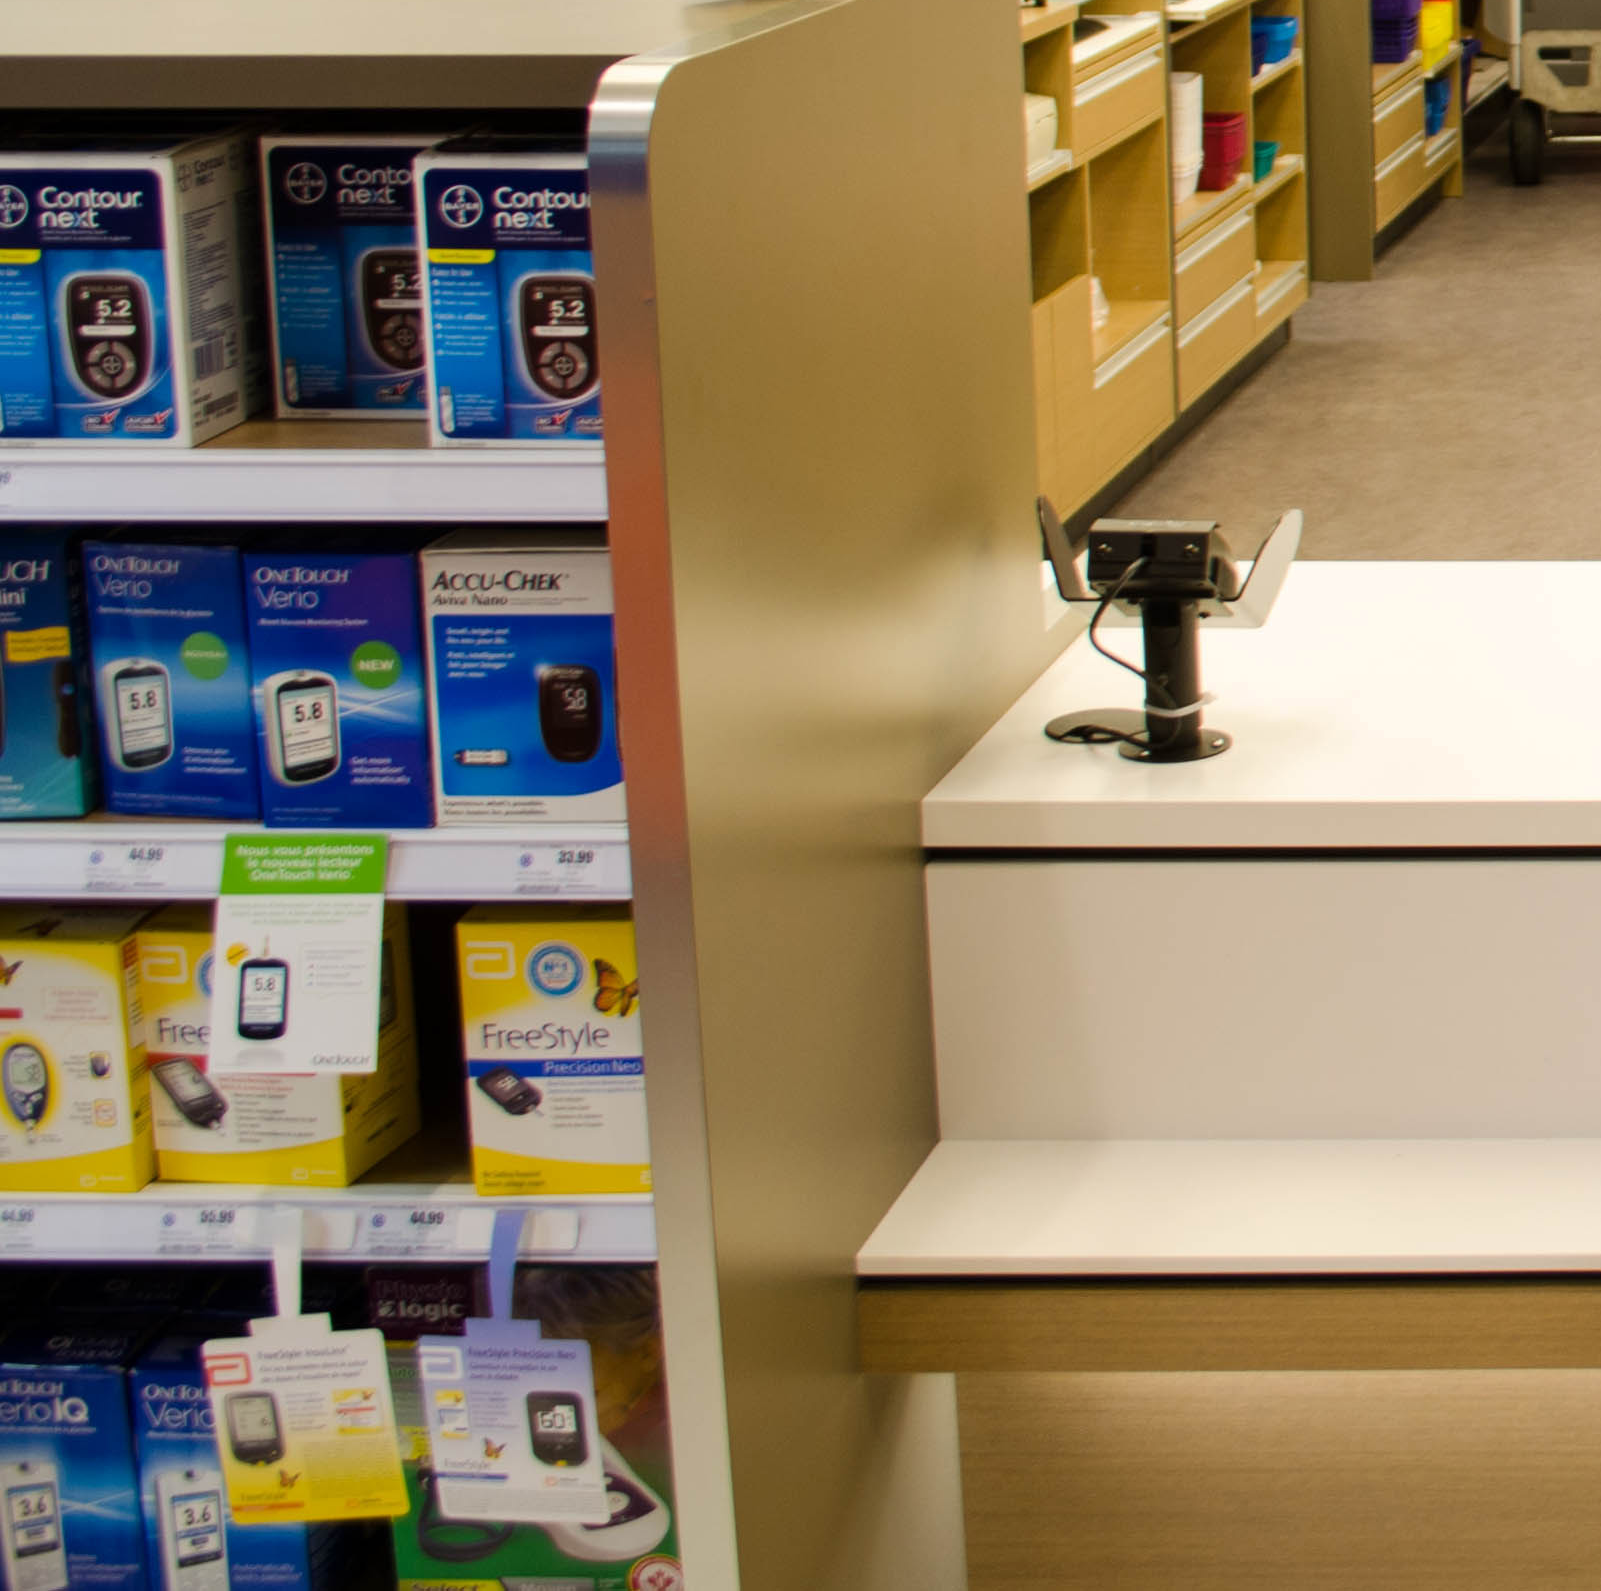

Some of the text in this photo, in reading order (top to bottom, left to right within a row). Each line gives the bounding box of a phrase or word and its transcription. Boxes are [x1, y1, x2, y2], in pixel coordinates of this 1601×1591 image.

[337, 164, 412, 185] Conto
[38, 186, 143, 209] Contour
[338, 186, 396, 206] next
[40, 209, 99, 229] next
[493, 209, 554, 229] next
[97, 299, 132, 318] 5.2
[550, 299, 585, 318] 5.2
[96, 574, 153, 599] Verio
[432, 570, 563, 591] ACCU-CHEK
[256, 585, 320, 610] Verio
[471, 593, 509, 607] Nano
[358, 659, 395, 672] NEW
[130, 690, 158, 711] 5.8
[294, 700, 325, 723] 5.8
[236, 844, 270, 856] Nous
[304, 844, 374, 857] présentons
[482, 1022, 611, 1055] FreeStyle
[544, 1058, 643, 1075] Precision Neo
[19, 1495, 49, 1518] 3.6
[184, 1504, 213, 1527] 3.6
